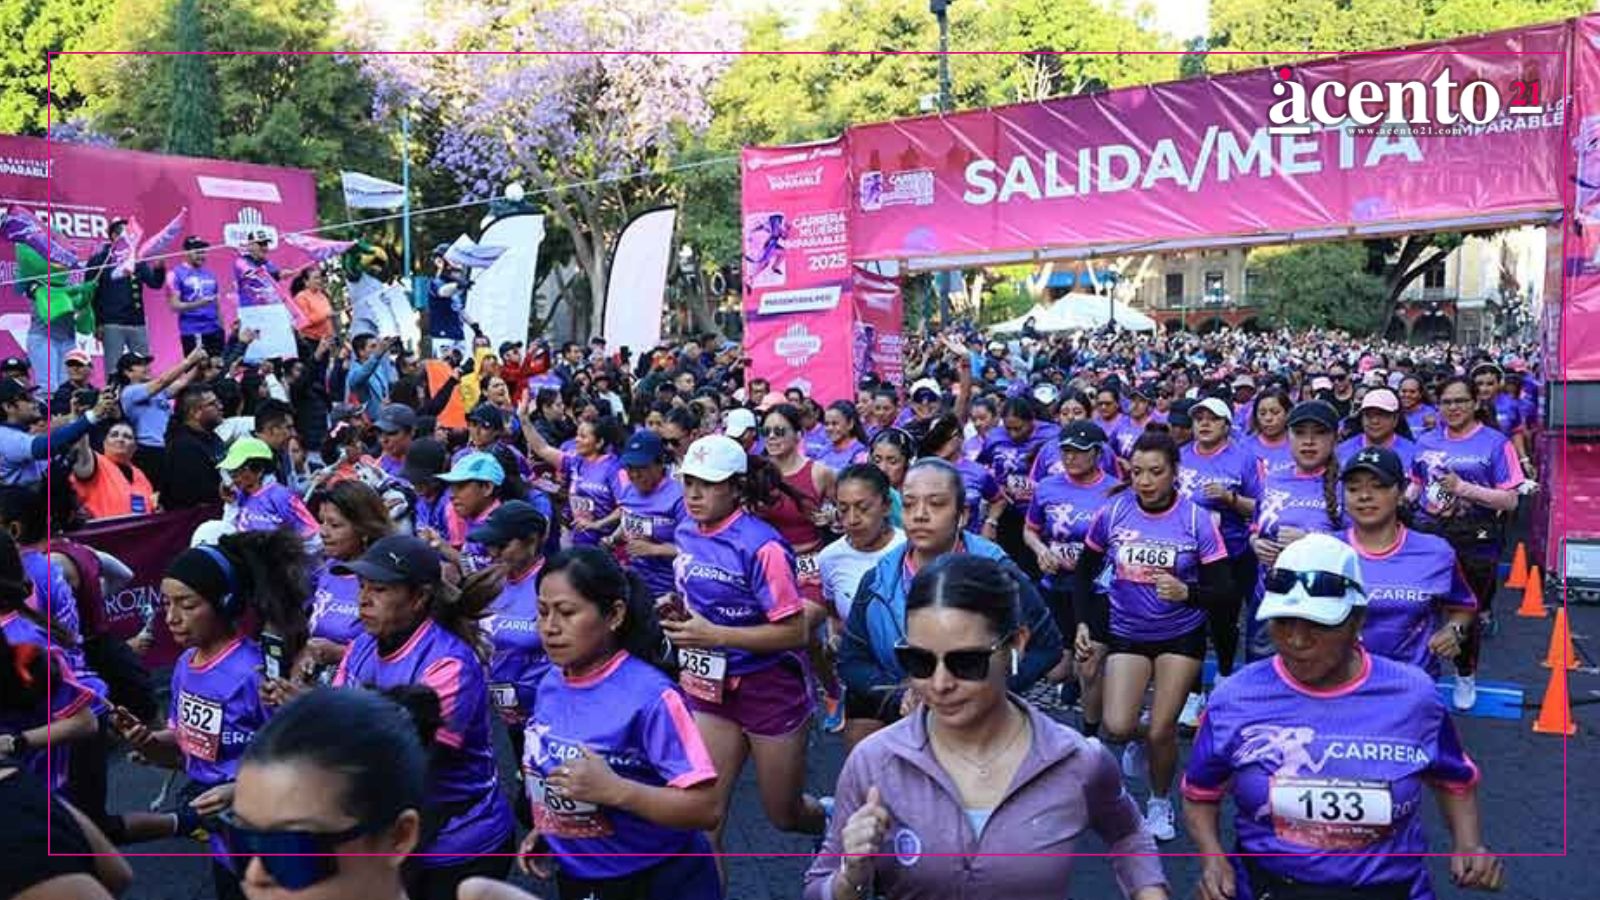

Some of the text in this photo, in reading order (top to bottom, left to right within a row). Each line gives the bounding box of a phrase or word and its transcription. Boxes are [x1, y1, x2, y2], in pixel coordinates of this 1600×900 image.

[962, 118, 1425, 206] SALIDA/META
[808, 253, 847, 271] 2025
[1126, 548, 1169, 566] 1466
[183, 701, 214, 731] 552
[1327, 741, 1430, 764] CARRERA
[1298, 788, 1365, 822] 133
